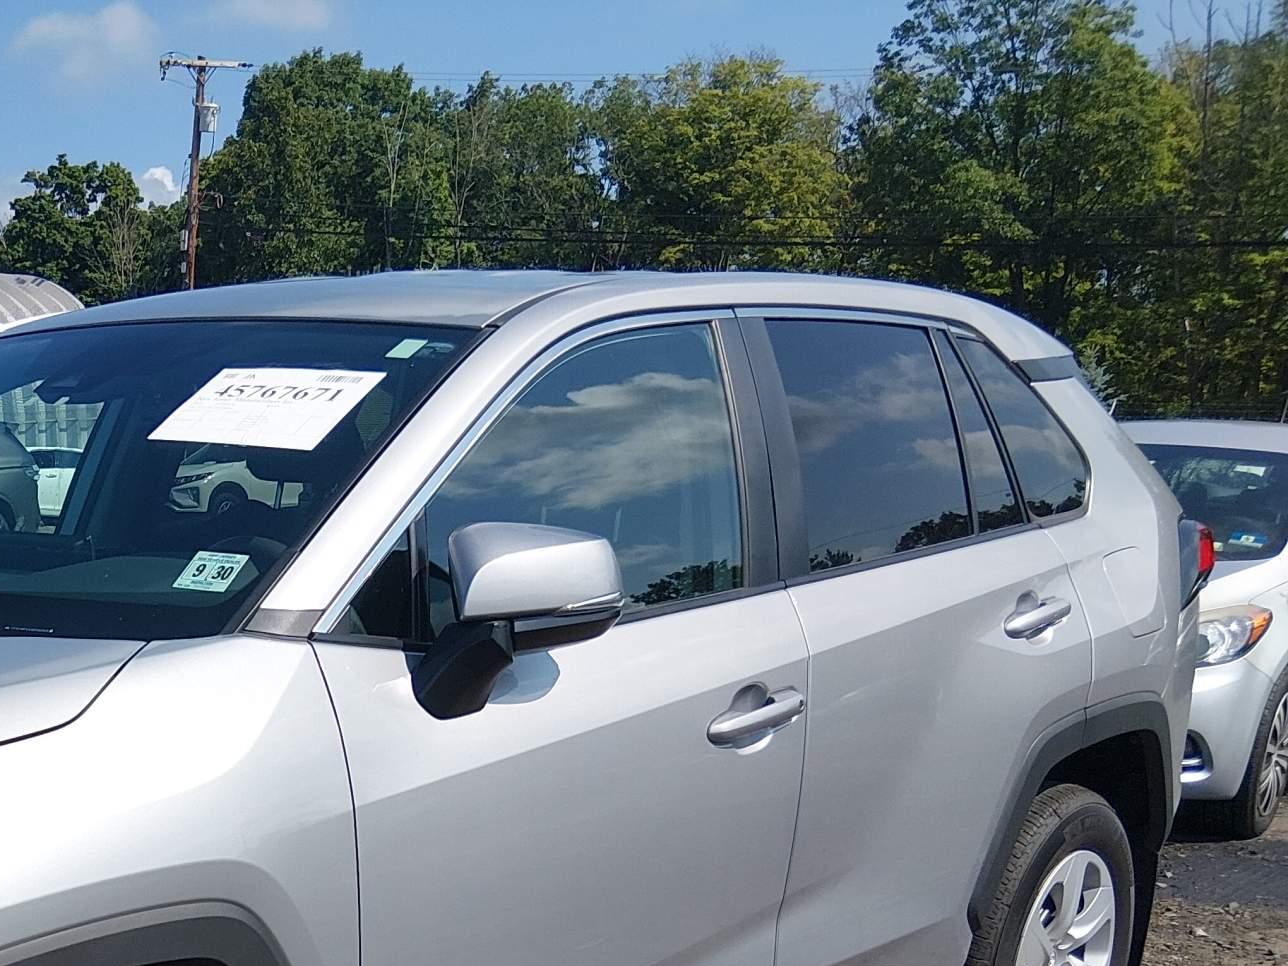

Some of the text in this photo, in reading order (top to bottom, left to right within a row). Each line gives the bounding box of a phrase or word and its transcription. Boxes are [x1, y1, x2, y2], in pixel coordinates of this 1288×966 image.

[214, 384, 345, 402] 45767671
[191, 563, 235, 581] 9 30
